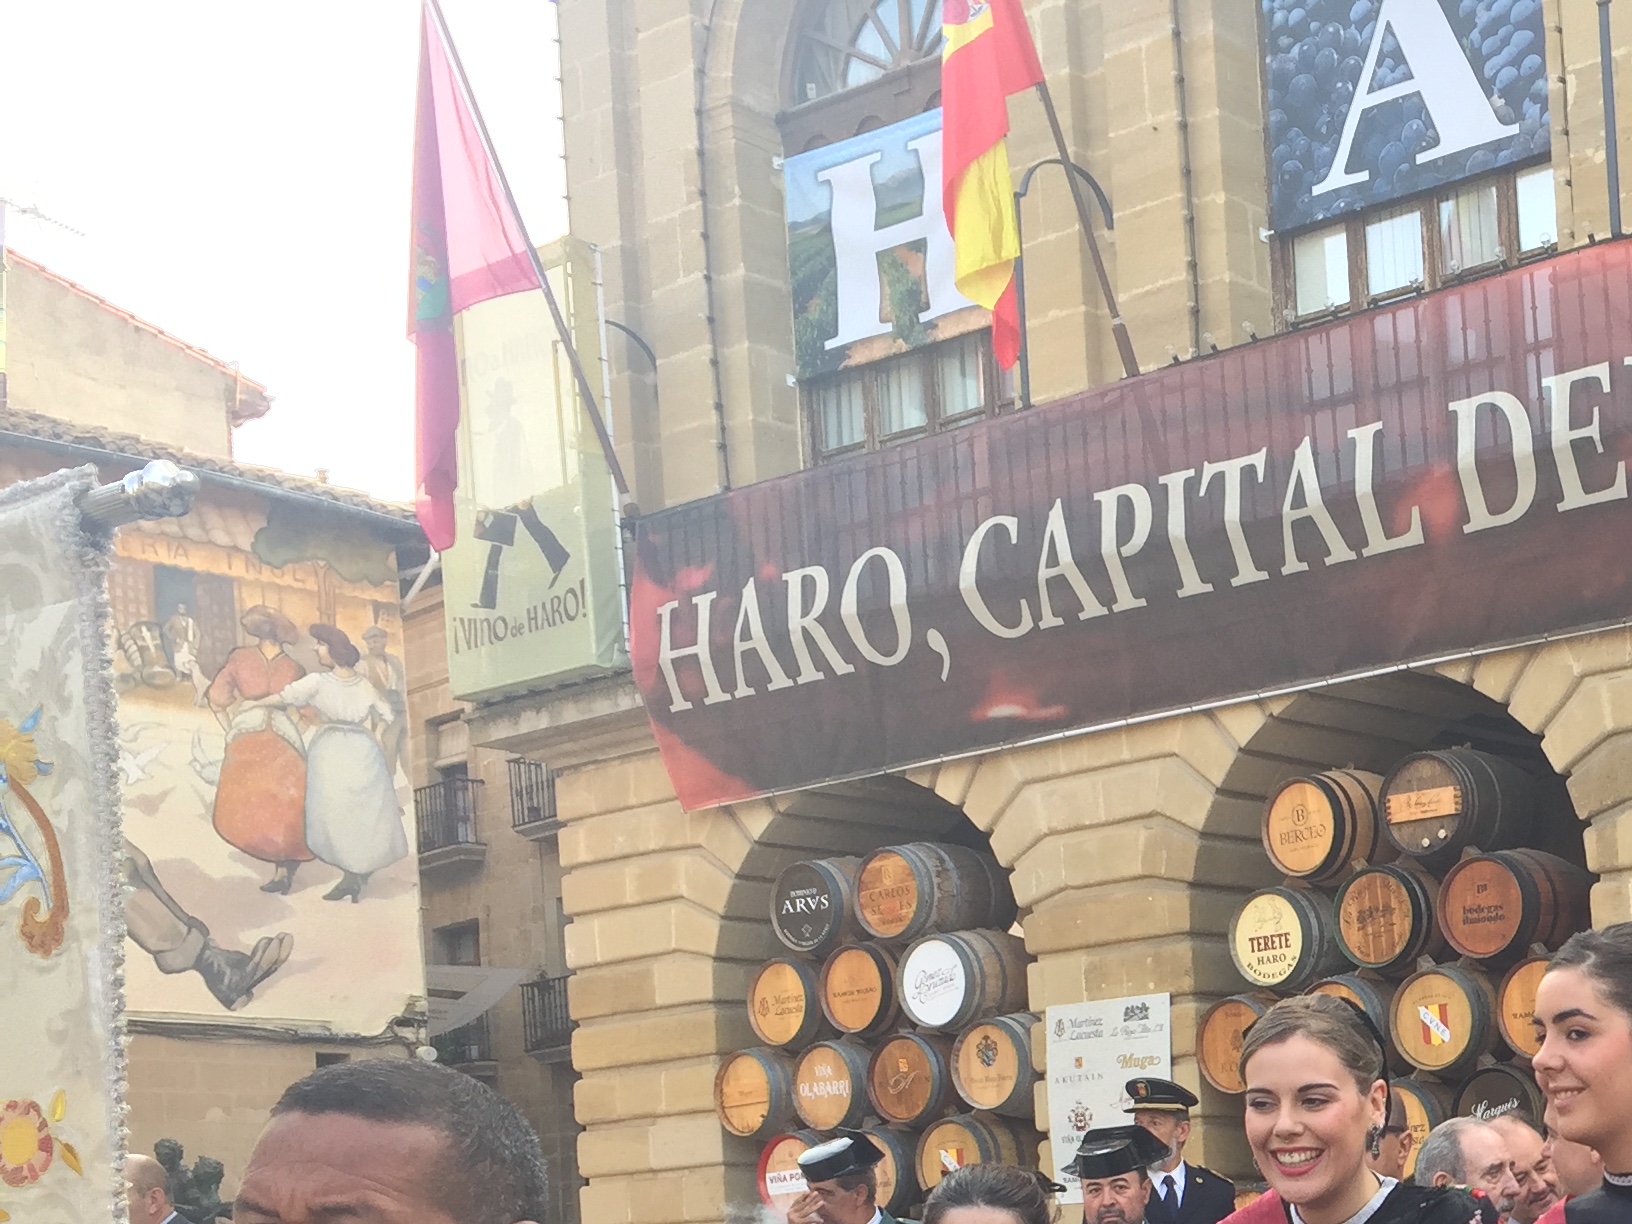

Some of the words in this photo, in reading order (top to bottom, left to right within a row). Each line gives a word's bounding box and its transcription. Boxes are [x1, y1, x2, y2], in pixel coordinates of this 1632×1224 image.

[1311, 0, 1519, 196] A
[657, 545, 951, 714] HARO,
[958, 421, 1423, 639] CAPITAL
[510, 616, 525, 638] de
[526, 579, 587, 633] HARO!
[1279, 823, 1326, 846] BERCEO
[1248, 932, 1291, 953] TERETE
[1246, 955, 1297, 979] BODEGAS
[1257, 953, 1286, 965] HARO
[1116, 1053, 1161, 1070] Muga
[1055, 1072, 1104, 1084] AKUTAIN
[800, 1080, 849, 1099] OLABARRI
[1471, 1097, 1520, 1119] Marqués
